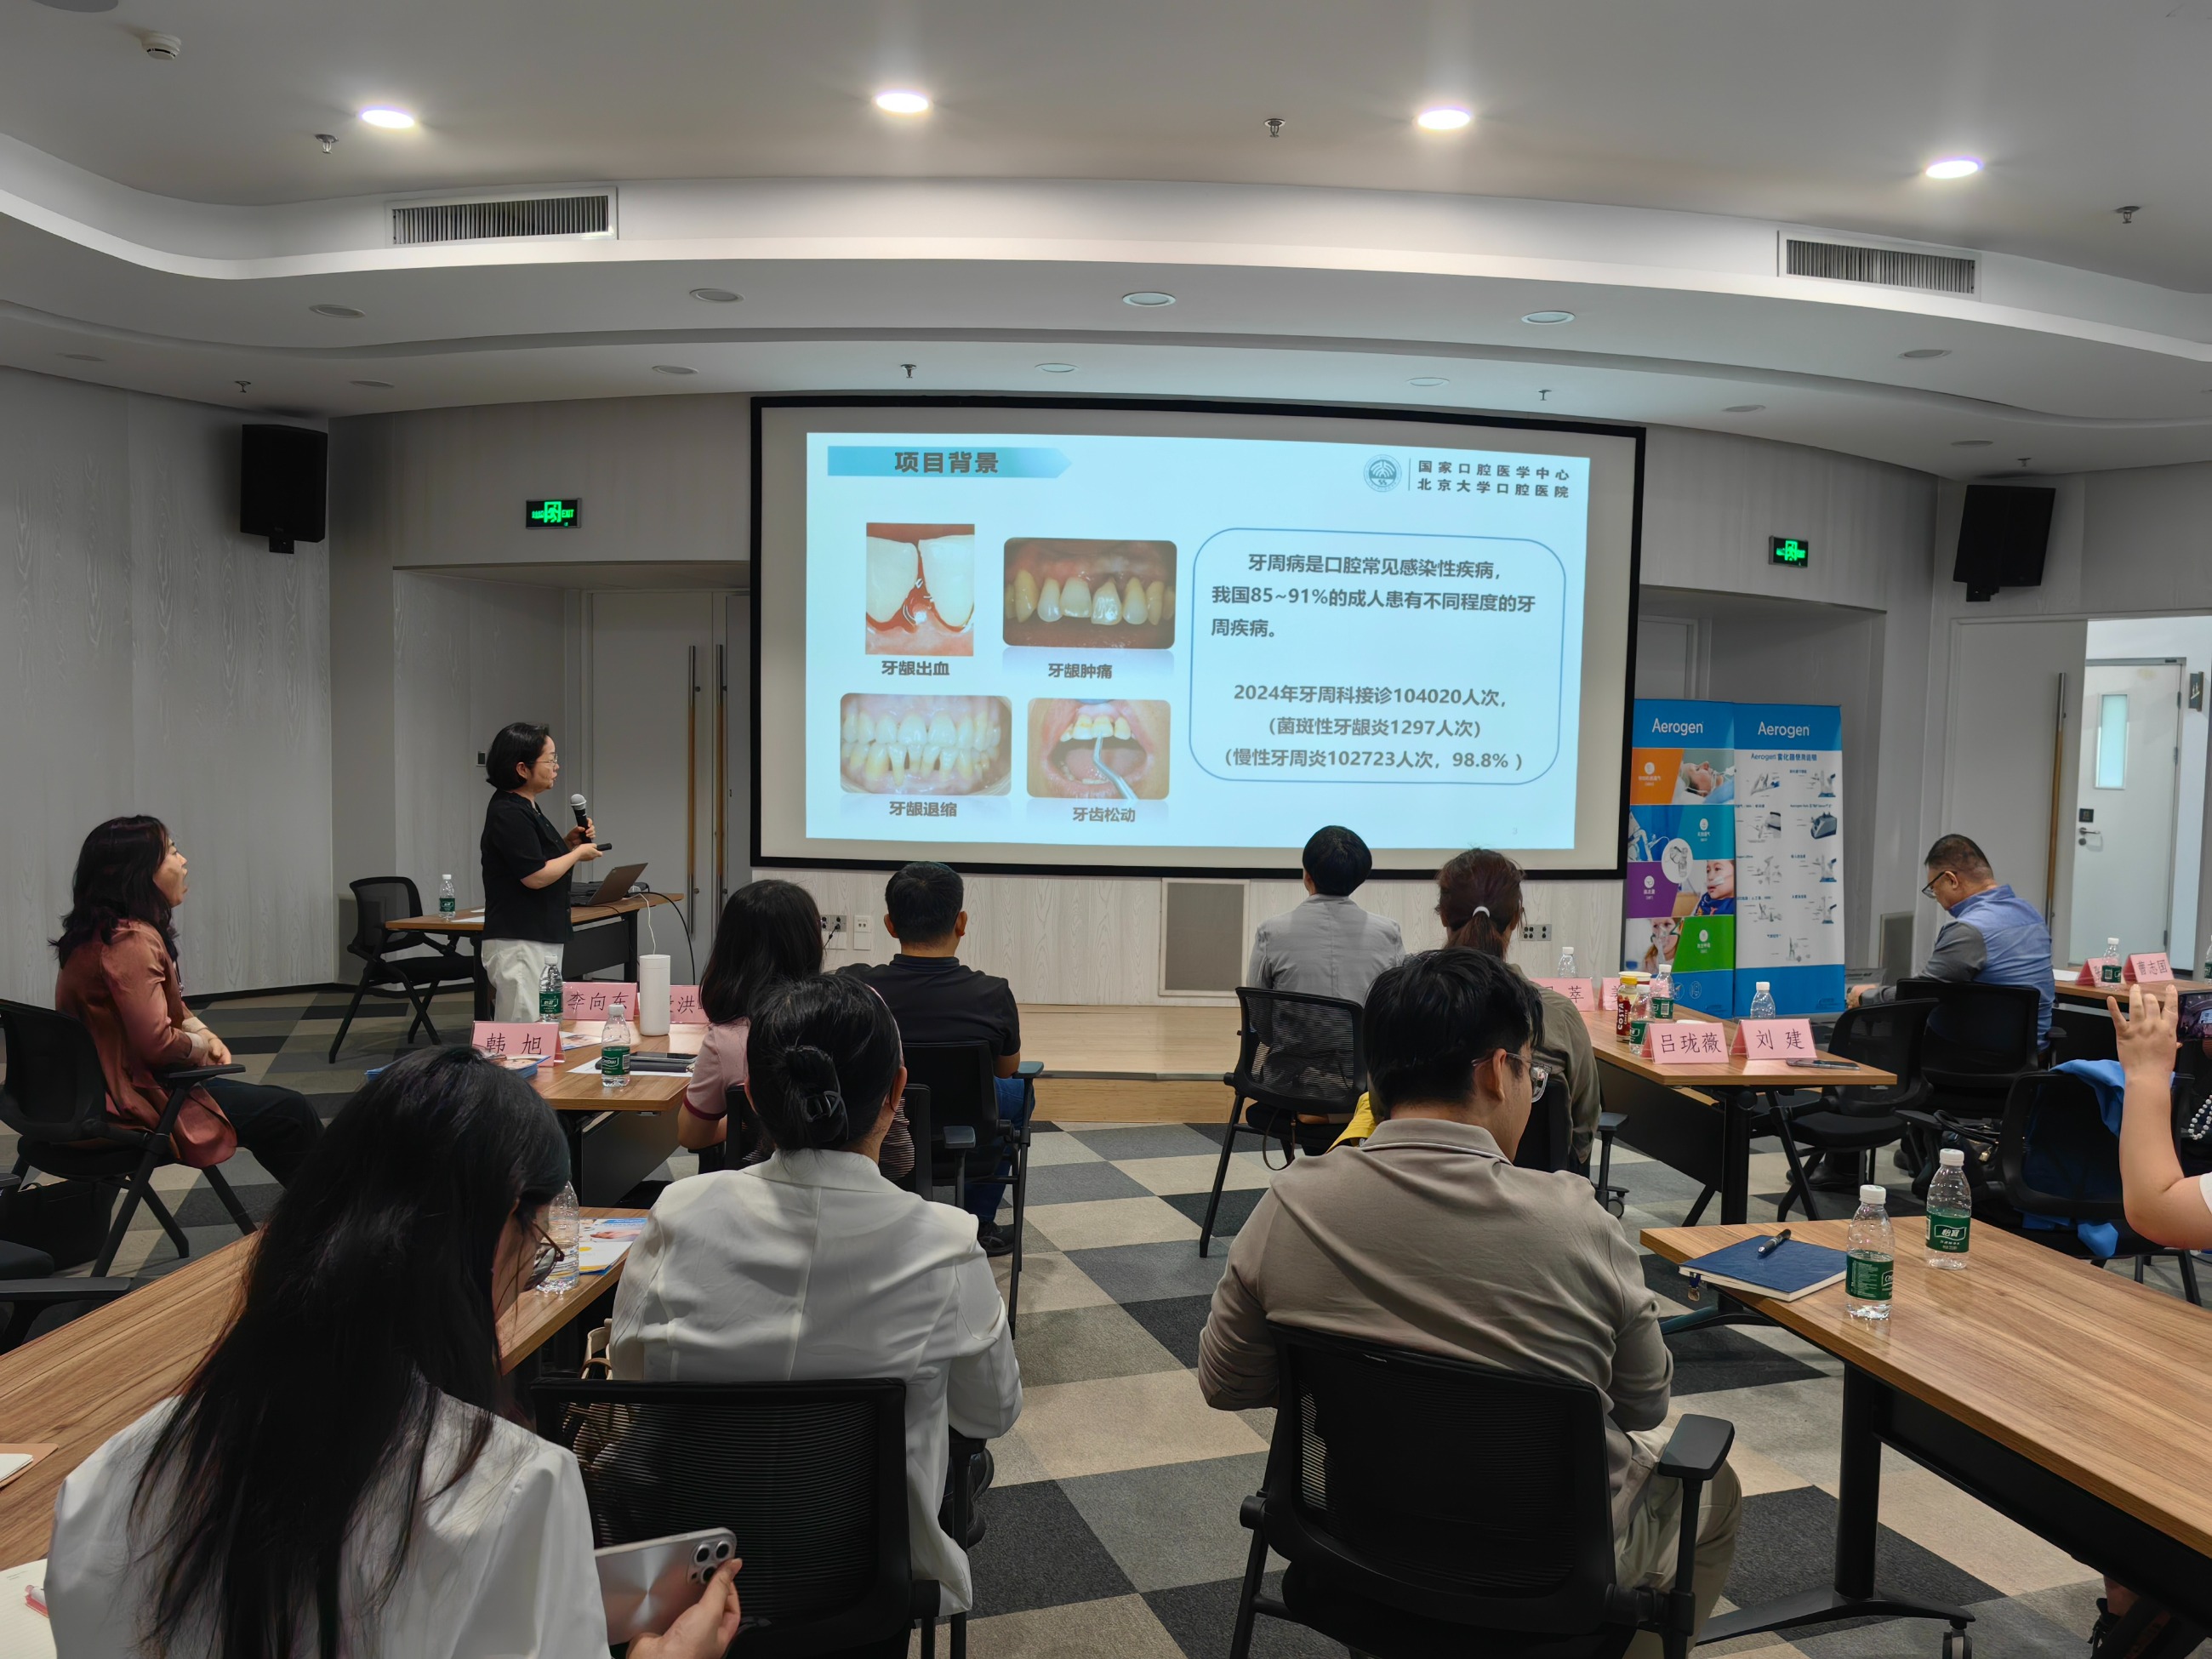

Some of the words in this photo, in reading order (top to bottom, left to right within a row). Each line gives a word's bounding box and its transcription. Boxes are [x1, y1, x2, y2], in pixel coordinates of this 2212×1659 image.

[894, 451, 999, 474] 项目背景
[1418, 460, 1570, 481] 国家口腔医学中心
[1417, 478, 1569, 499] 北京大学口腔医院
[1211, 584, 1536, 613] 我国85~91%的成人患有不同程度的牙
[1211, 618, 1276, 638] 周疾病。
[881, 660, 950, 676] 牙龈出血
[1047, 663, 1113, 680] 牙龈肿痛
[1651, 718, 1703, 736] Aerogen
[1758, 721, 1810, 738] Aerogen
[889, 801, 958, 818] 牙龈退缩
[1072, 807, 1136, 823] 牙齿松动
[567, 990, 629, 1012] 李向东
[486, 1032, 542, 1055] 韩旭
[1661, 1032, 1722, 1053] 吕珑薇
